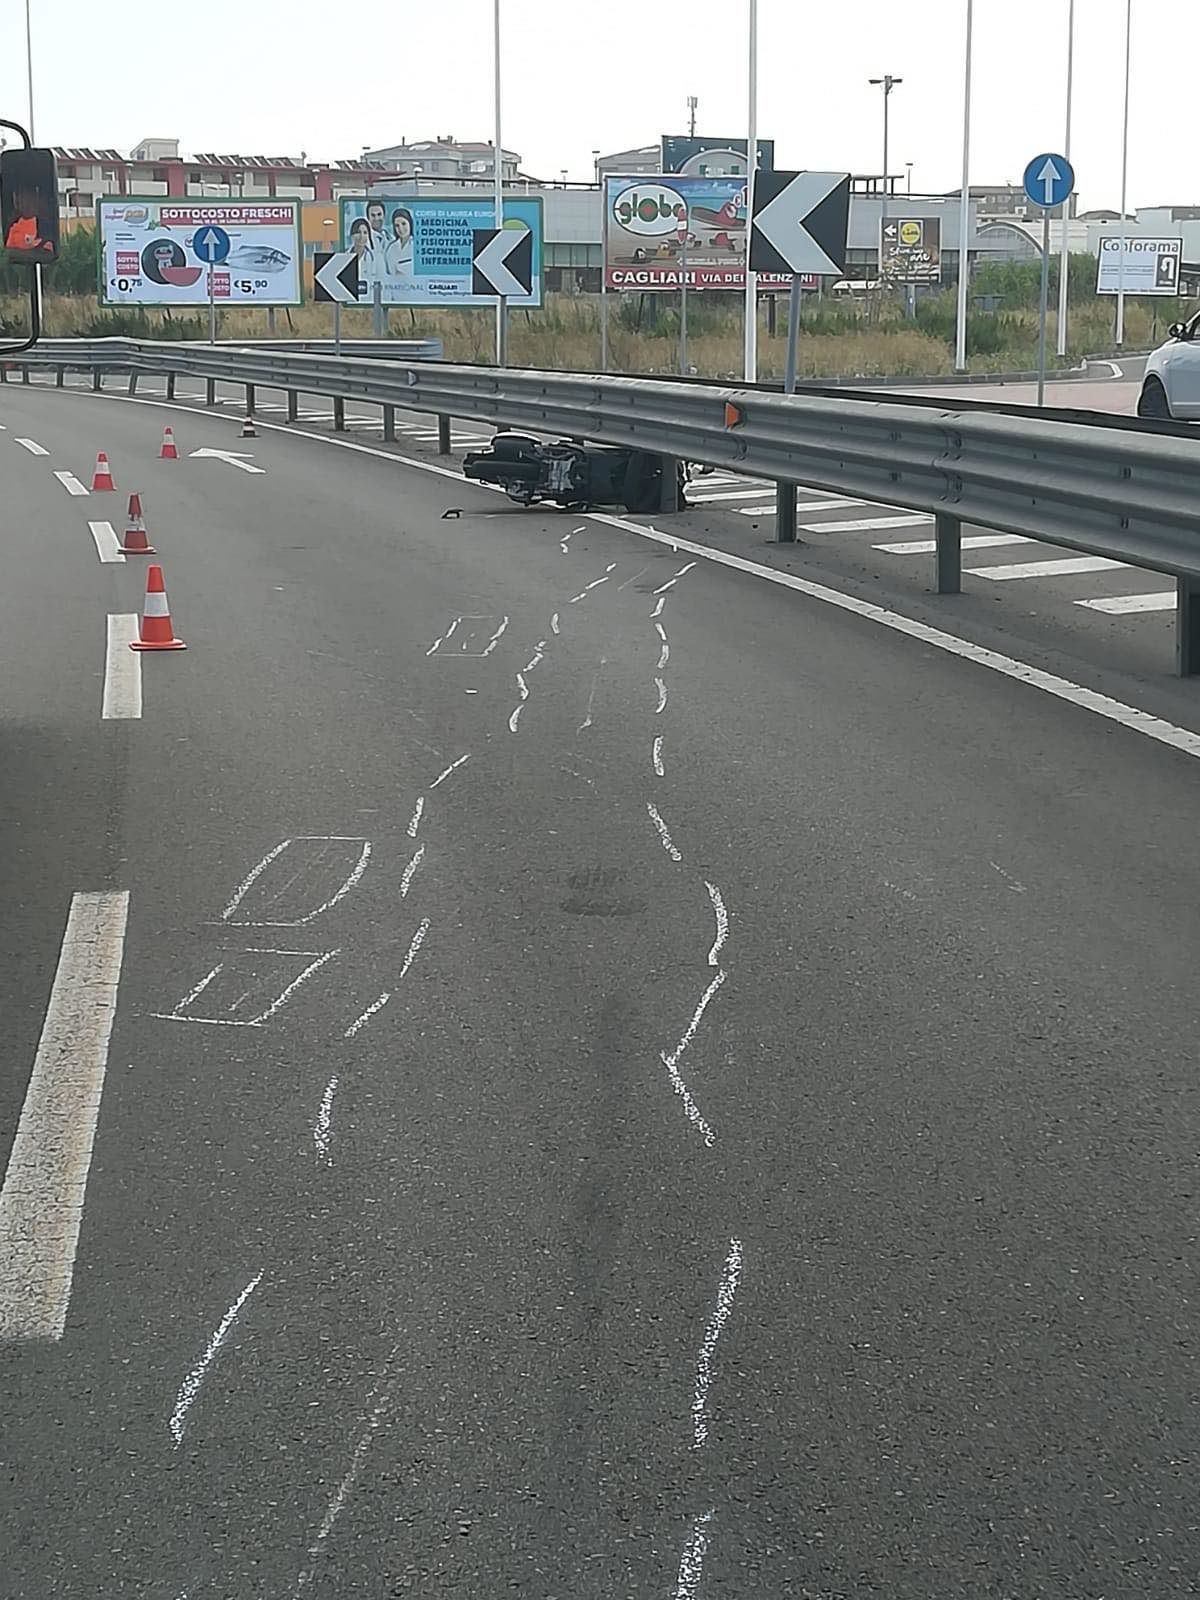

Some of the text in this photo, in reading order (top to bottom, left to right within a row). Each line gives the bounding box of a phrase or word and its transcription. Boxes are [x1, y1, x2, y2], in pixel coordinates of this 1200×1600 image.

[162, 207, 291, 218] SOTTOCOSTO FRESCHI
[611, 271, 813, 284] CAGLIARI VIA DEI ALENZNI
